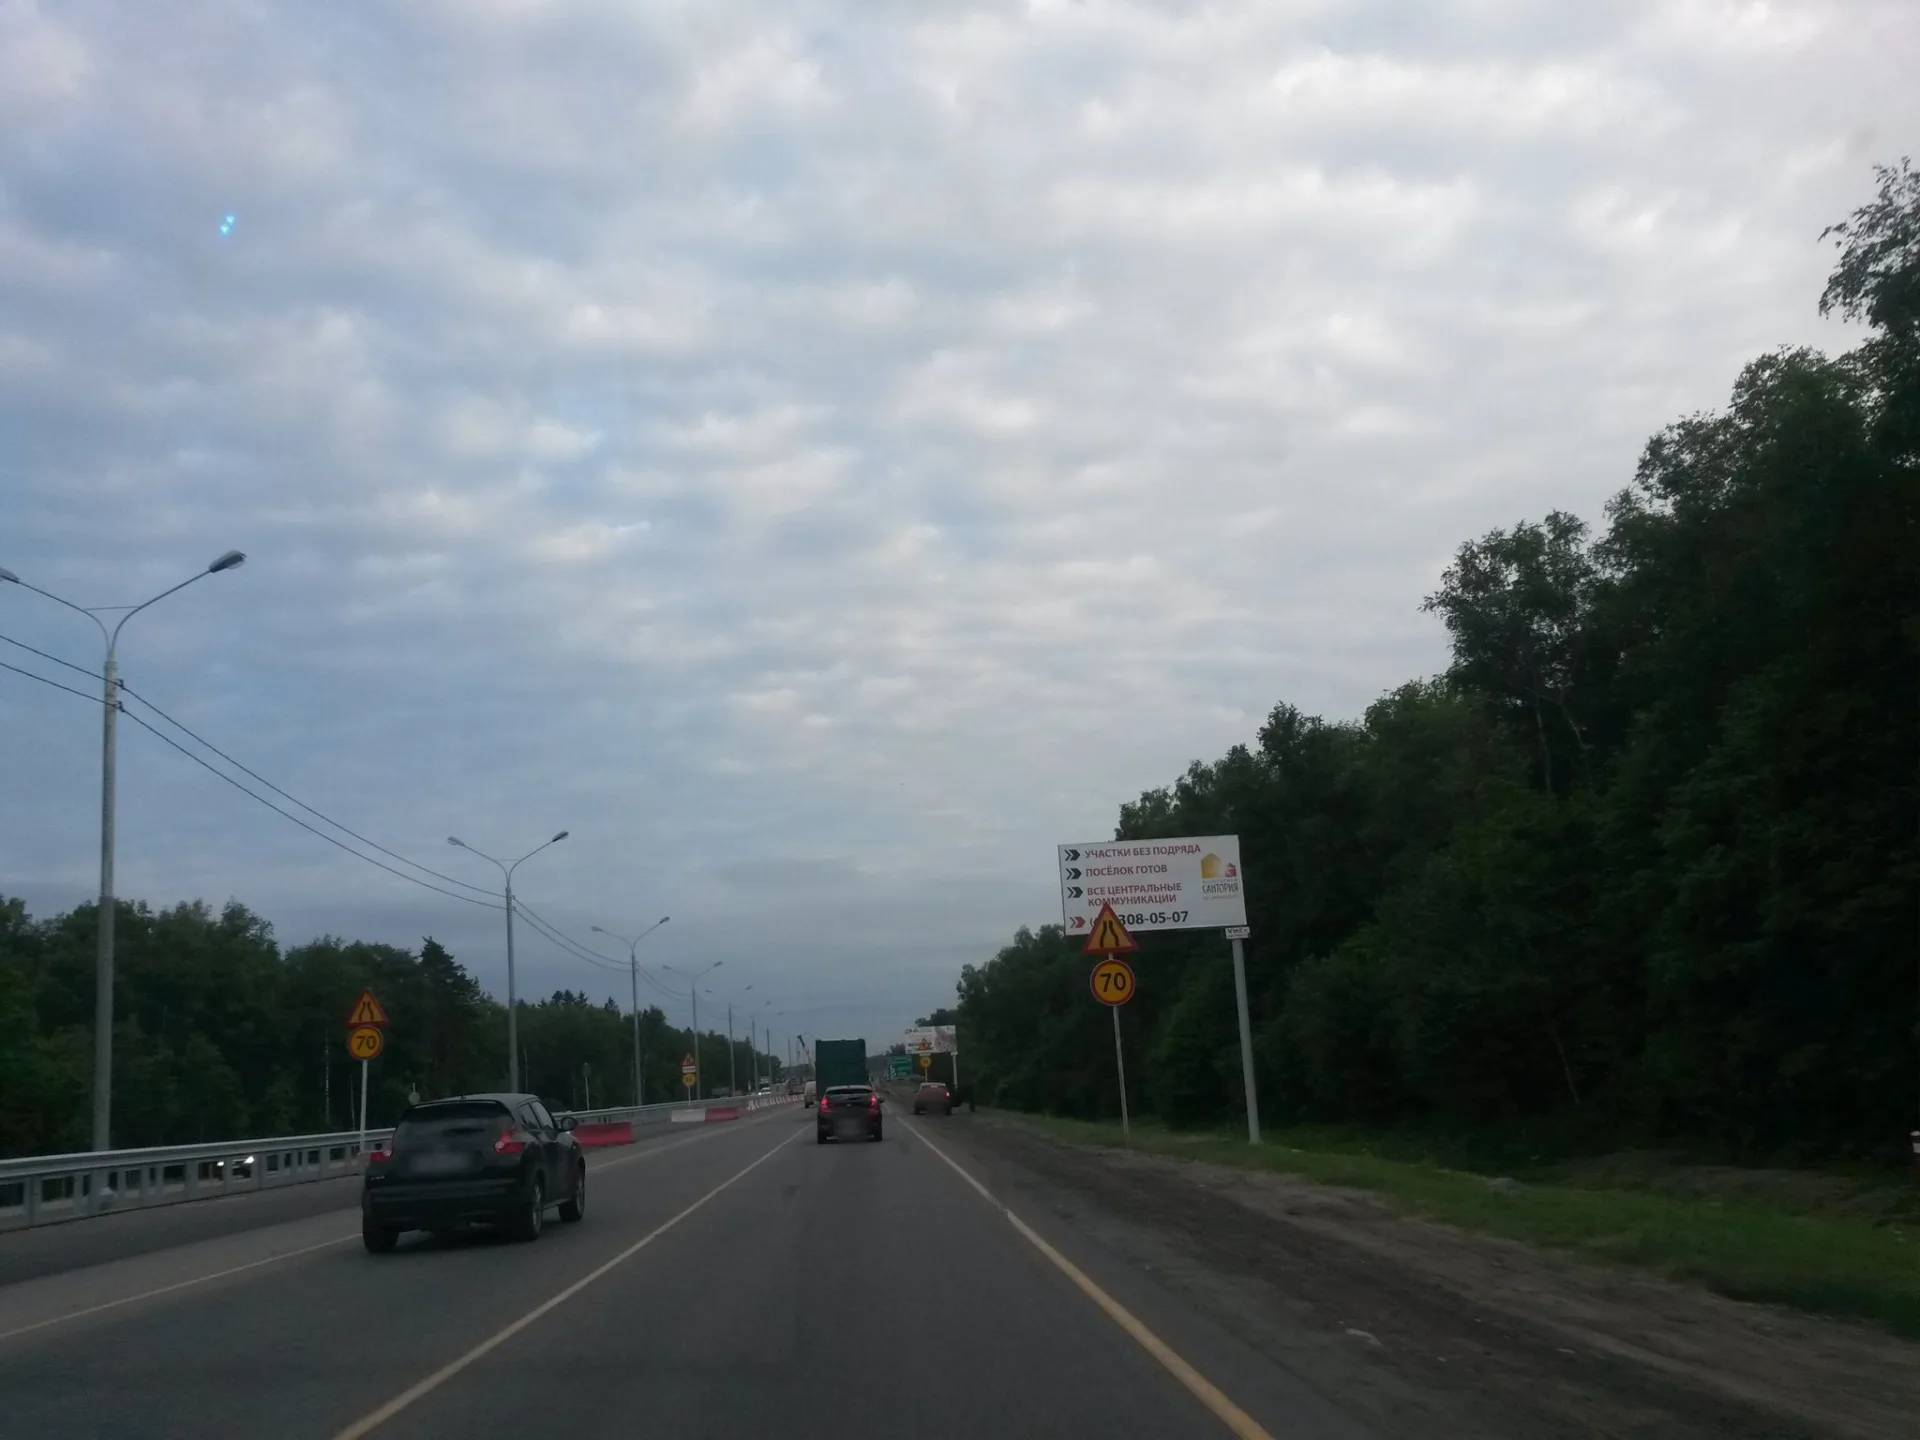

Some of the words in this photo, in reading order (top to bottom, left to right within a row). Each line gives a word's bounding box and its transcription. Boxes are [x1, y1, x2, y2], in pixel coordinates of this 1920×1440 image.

[1085, 847, 1131, 859] УЧАСТКИ
[1133, 846, 1150, 856] БЕЗ
[1153, 844, 1201, 856] ПОДРЯДА
[1086, 864, 1134, 877] ПОСЁЛОК
[1136, 864, 1168, 875] ГОТОВ
[1087, 885, 1106, 896] ВСЕ
[1108, 882, 1182, 895] ЦЕНТРАЛЬНЫЕ
[1100, 972, 1126, 992] 70
[355, 1035, 377, 1050] 70
